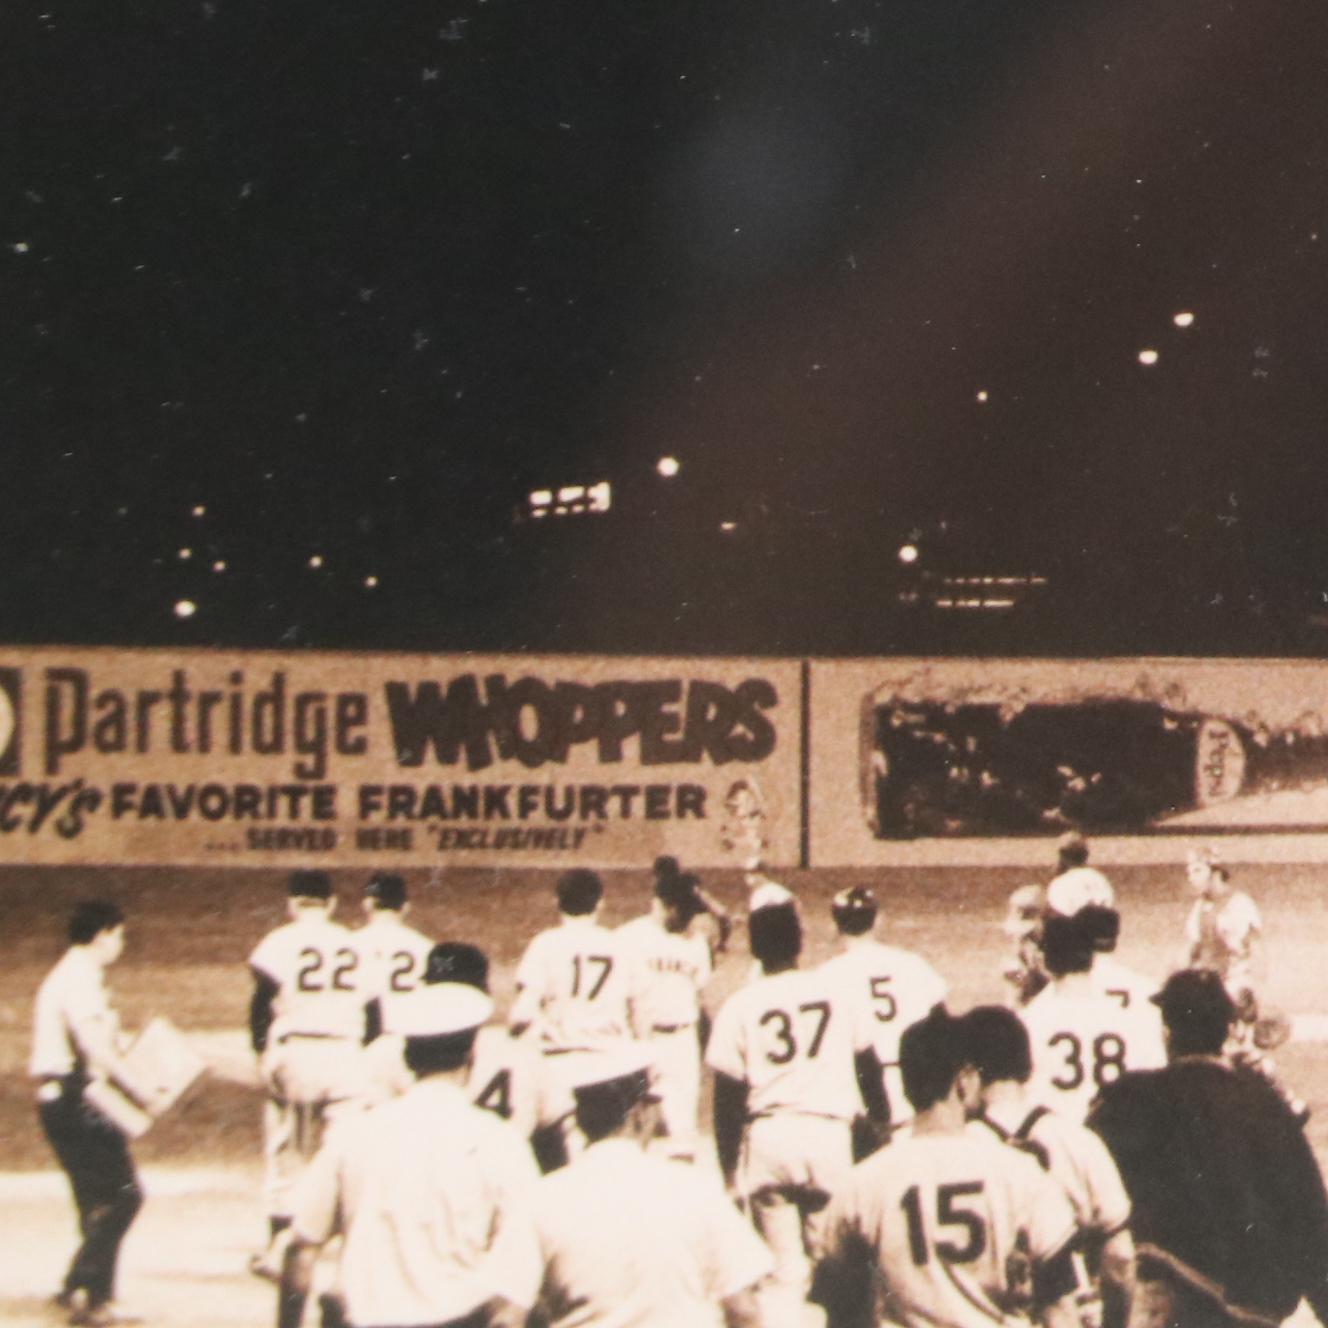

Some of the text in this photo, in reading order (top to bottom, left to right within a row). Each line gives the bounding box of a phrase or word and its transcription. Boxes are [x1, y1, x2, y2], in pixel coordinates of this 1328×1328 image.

[45, 667, 780, 779] Partridge WHOPPERS
[111, 782, 337, 821] FAVORITE
[358, 783, 707, 821] FRANKFURTER
[299, 948, 359, 991] 22
[388, 950, 417, 992] 2
[570, 955, 613, 1002] 17
[868, 976, 898, 1022] 5
[758, 1000, 833, 1065] 37
[1046, 1032, 1127, 1091] 38
[900, 1180, 986, 1266] 15
